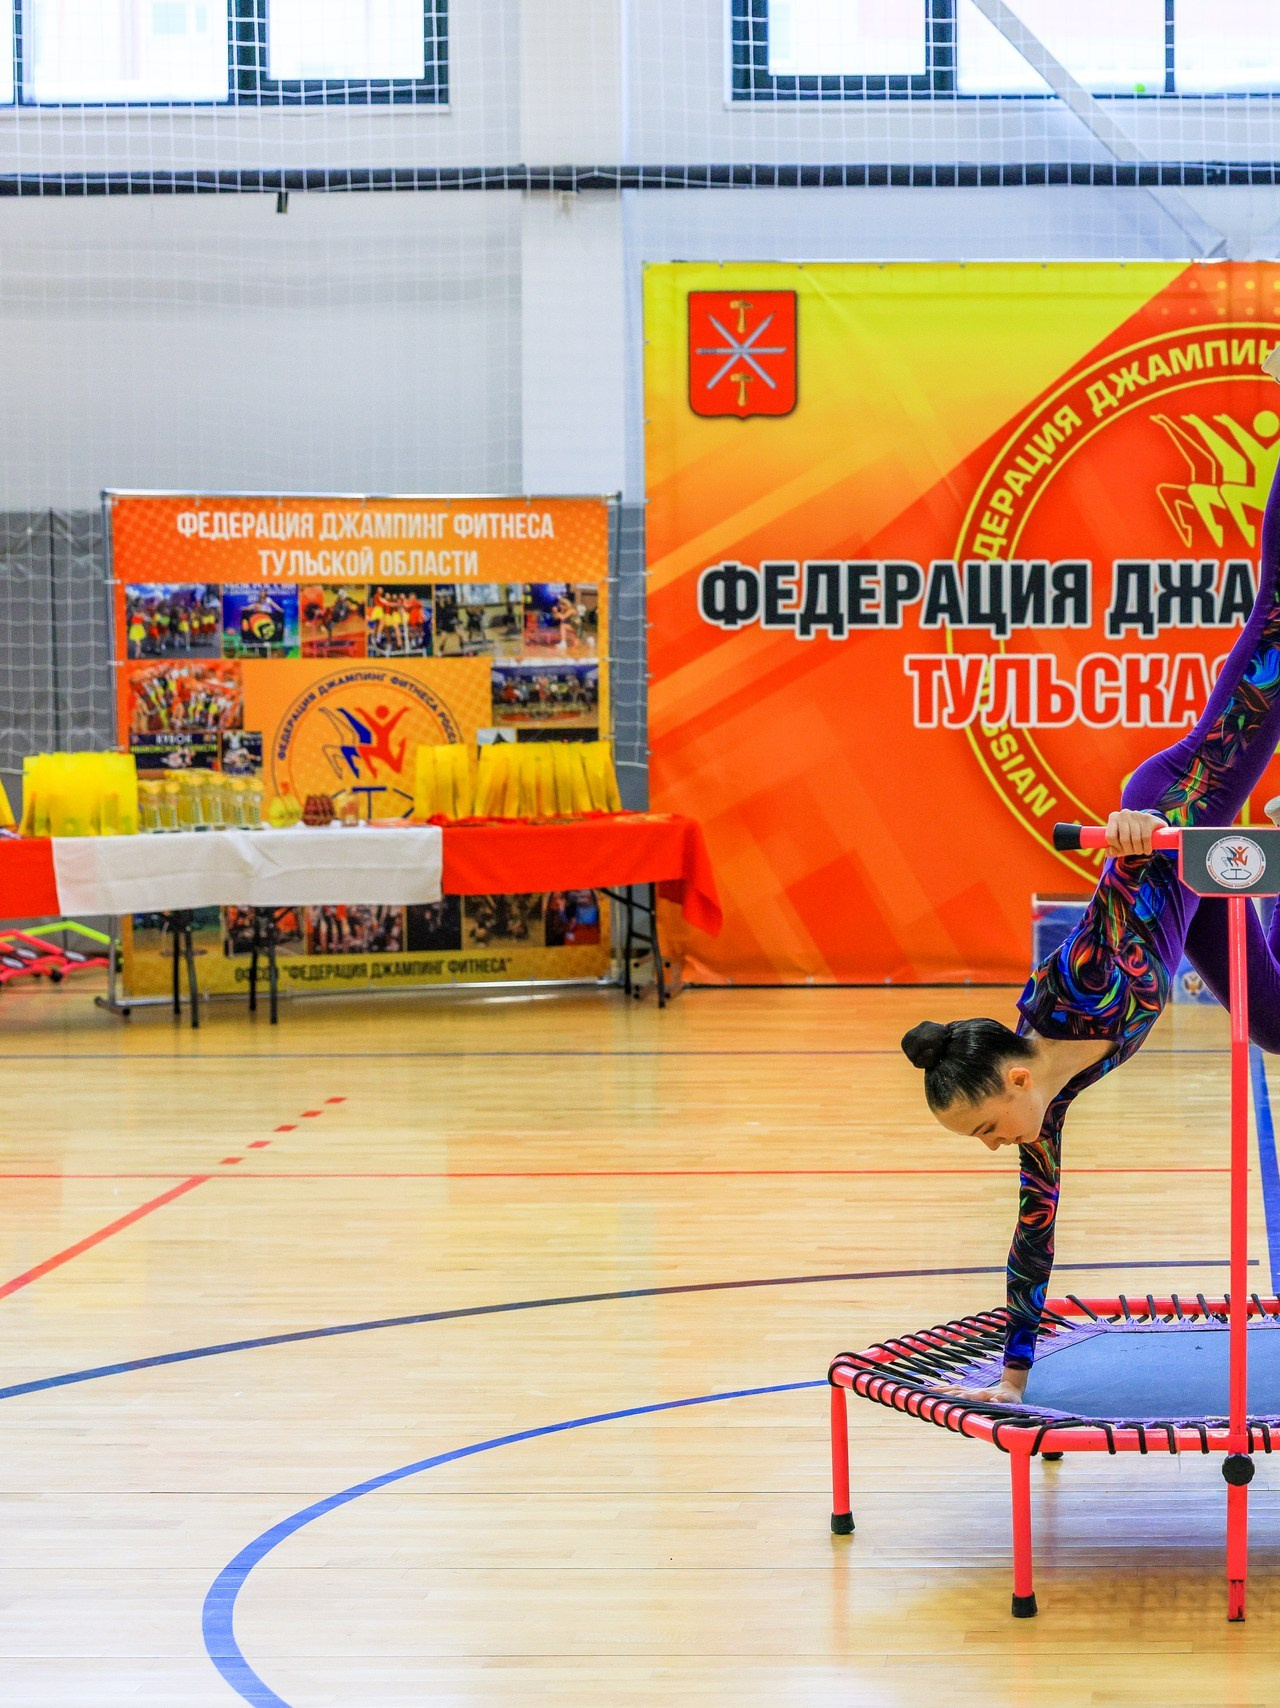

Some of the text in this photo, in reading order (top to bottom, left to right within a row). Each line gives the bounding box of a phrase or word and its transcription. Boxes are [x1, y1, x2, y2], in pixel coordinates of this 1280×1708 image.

[972, 405, 1083, 561] ДЕРАЦИЯ
[176, 511, 555, 541] ФЕДЕРАЦИЯ ДЖАМПИНГ ФИТНЕСА
[258, 547, 479, 577] ТУЛЬСКОЙ ОБЛАСТИ
[700, 560, 1091, 639] ФЕДЕРАЦИЯ
[904, 652, 1226, 728] ТУЛЬСКА
